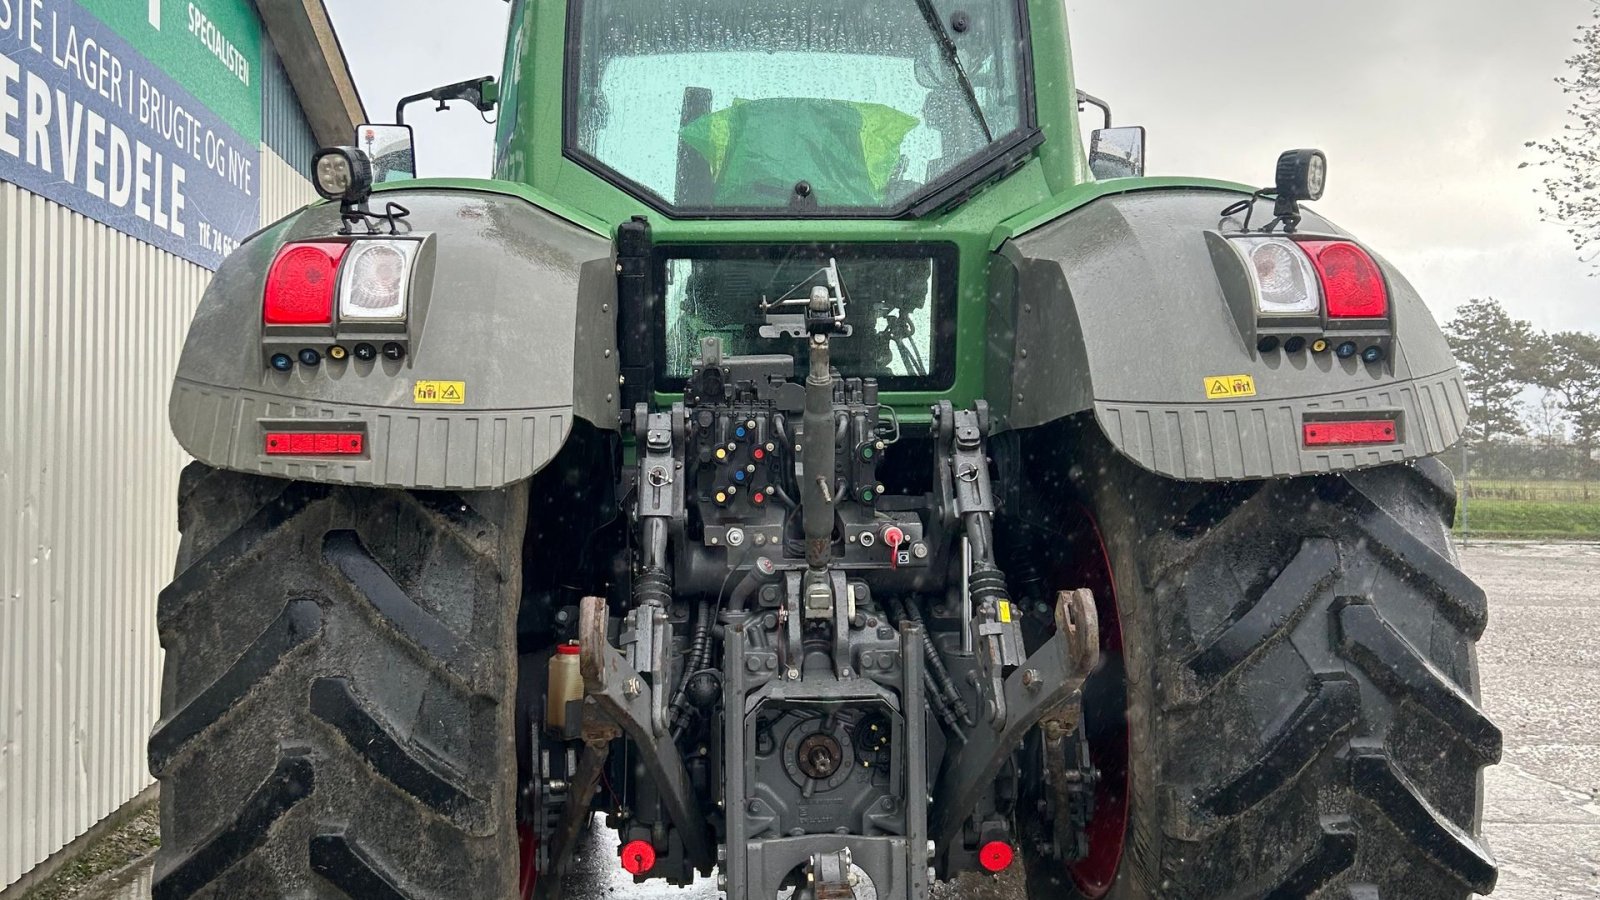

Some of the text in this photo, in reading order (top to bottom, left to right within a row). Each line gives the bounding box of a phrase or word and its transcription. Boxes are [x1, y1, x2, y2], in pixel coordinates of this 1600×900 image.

[52, 10, 123, 109] LAGER
[129, 69, 134, 115] I
[139, 77, 201, 161] BRUGTE
[205, 130, 225, 177] OG
[228, 146, 252, 196] NYE
[188, 2, 249, 87] SPECIALISTEN
[0, 52, 186, 238] ERVEDELE
